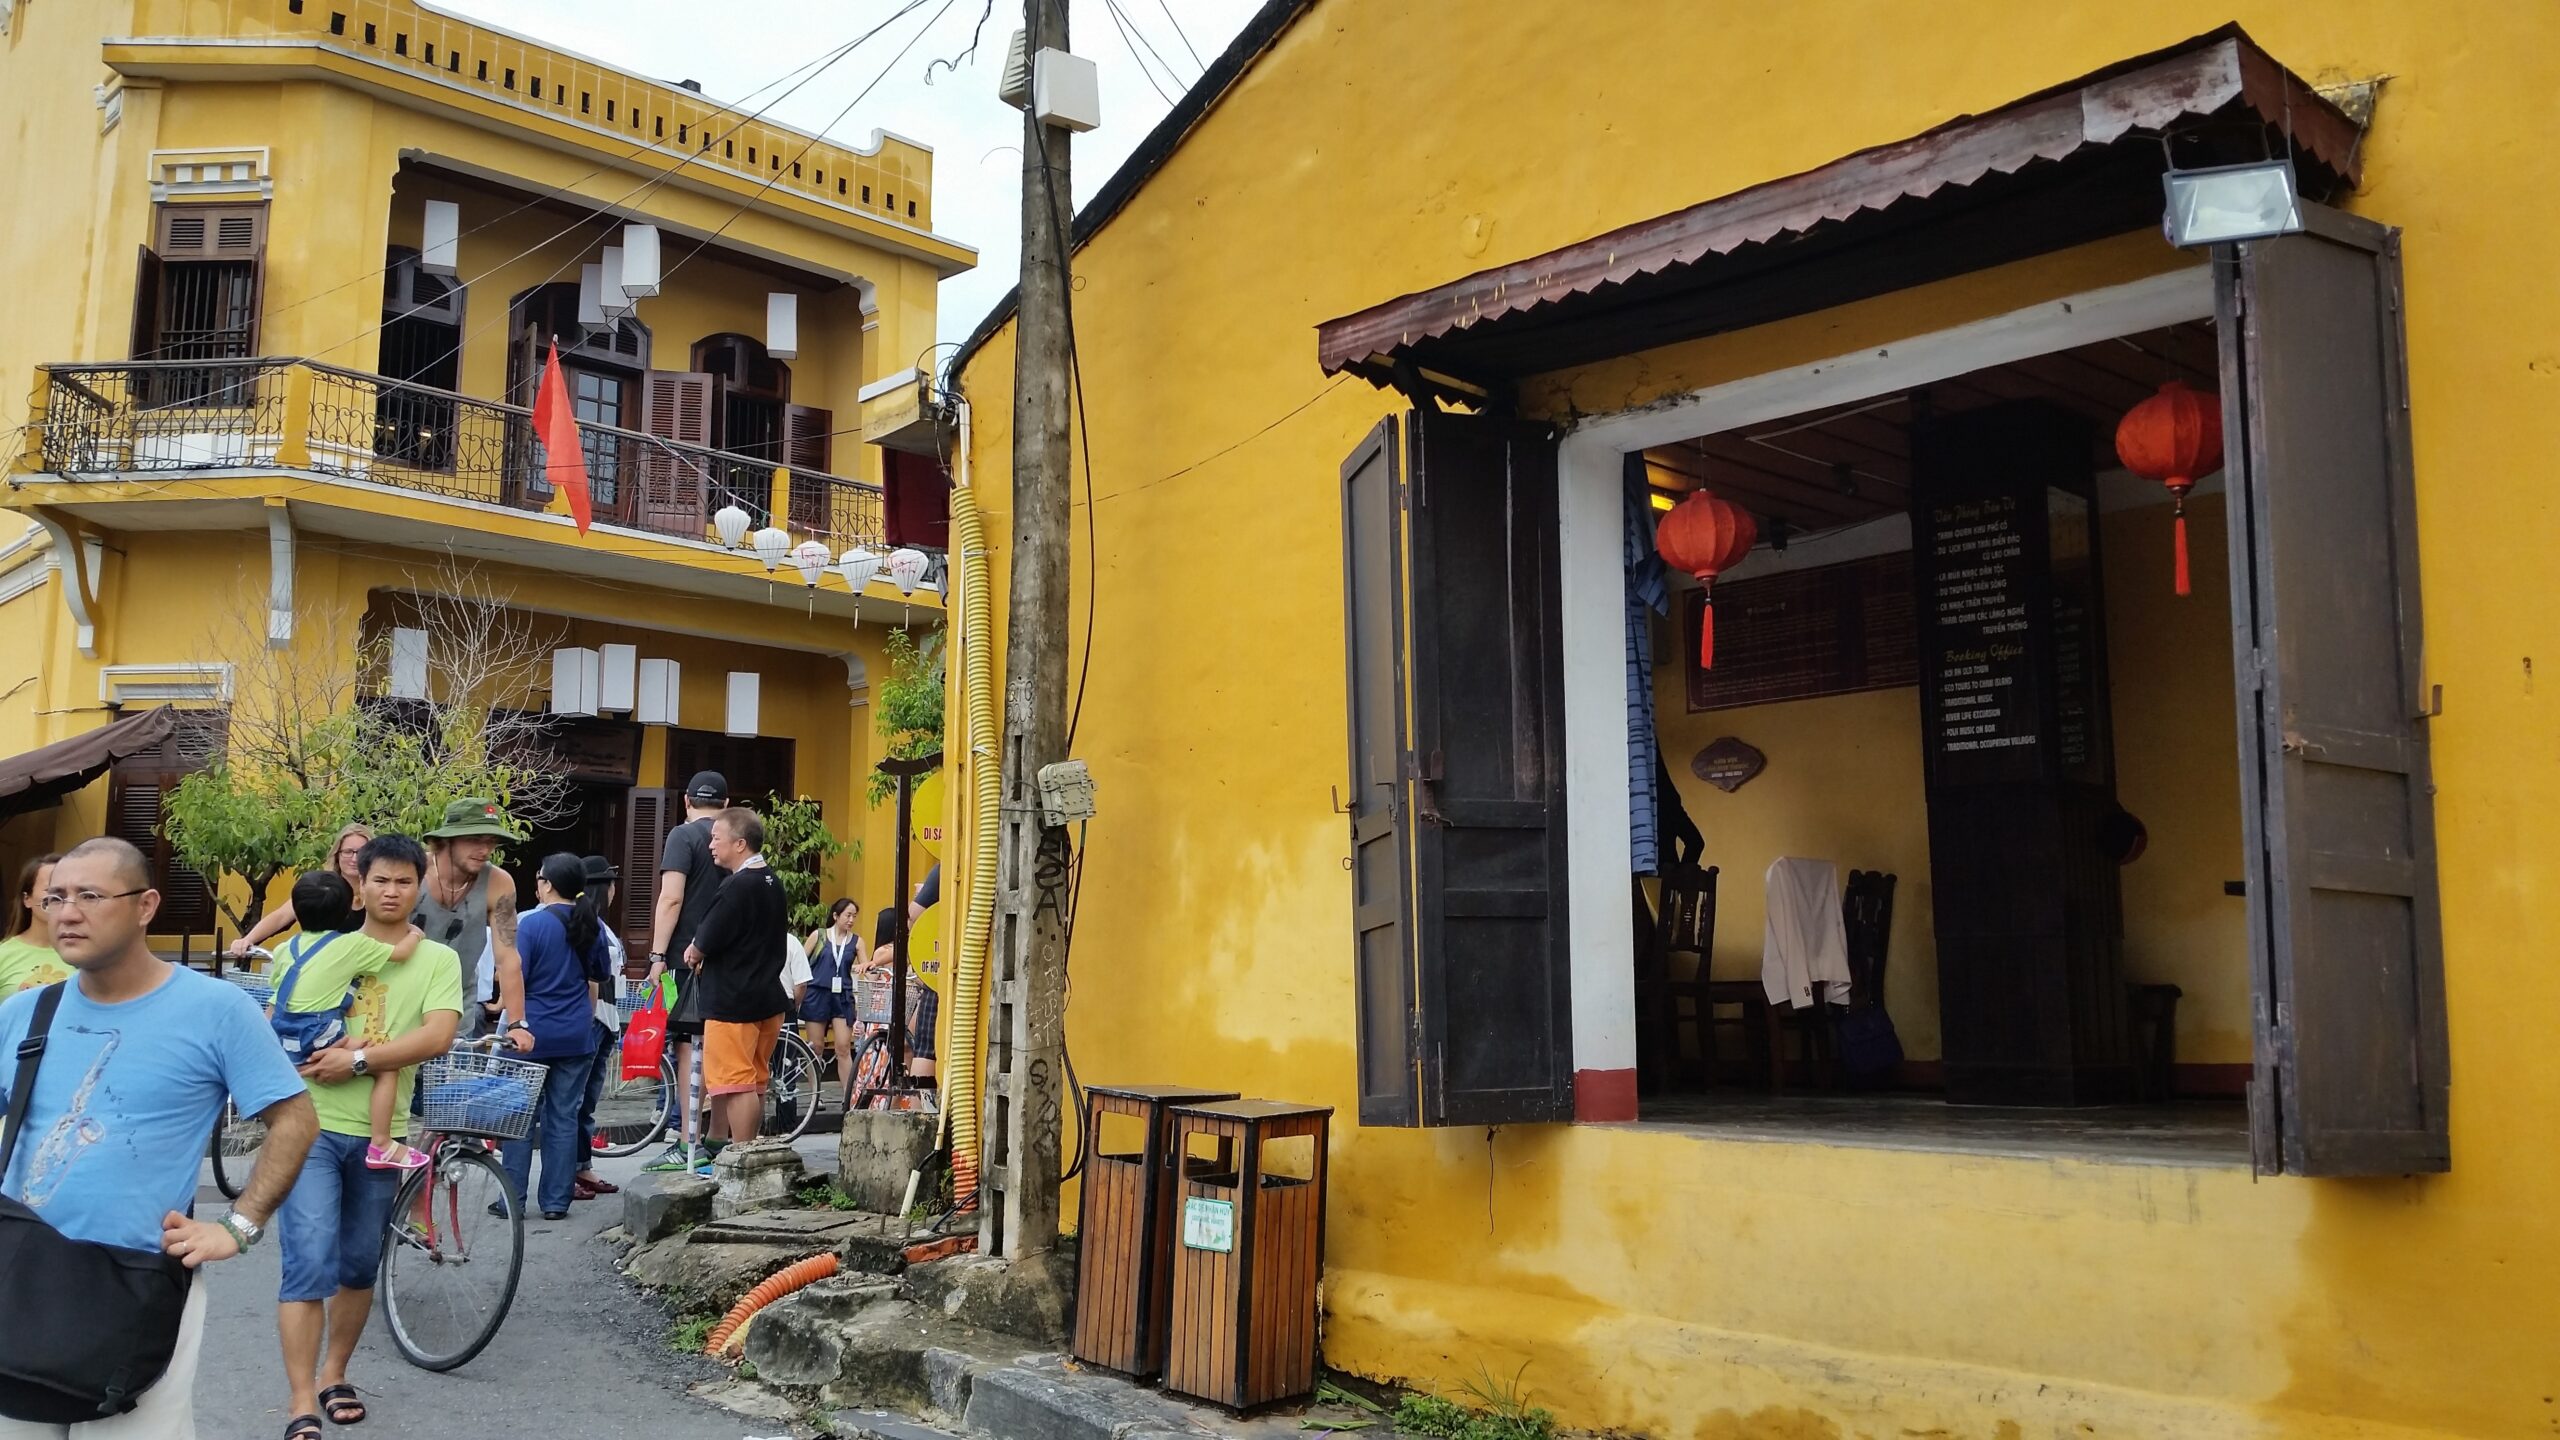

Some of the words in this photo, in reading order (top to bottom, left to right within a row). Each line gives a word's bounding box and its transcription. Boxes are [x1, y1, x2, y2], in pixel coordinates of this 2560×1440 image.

[1945, 649, 1987, 662] Booking
[1991, 643, 2024, 661] Office
[1955, 681, 1971, 691] TOURS
[1972, 680, 1979, 689] TO
[1944, 696, 1976, 707] TRADITIONAL
[1977, 694, 1993, 703] MUSIC
[1945, 712, 1960, 722] RIVER
[1961, 711, 1972, 720] LIFE
[1959, 725, 1975, 735] MUSIC
[1975, 725, 1984, 733] ON
[1947, 741, 1979, 751] TRADITIONAL
[2011, 735, 2036, 745] VILLAGES
[923, 827, 931, 840] DI
[921, 961, 929, 972] OF
